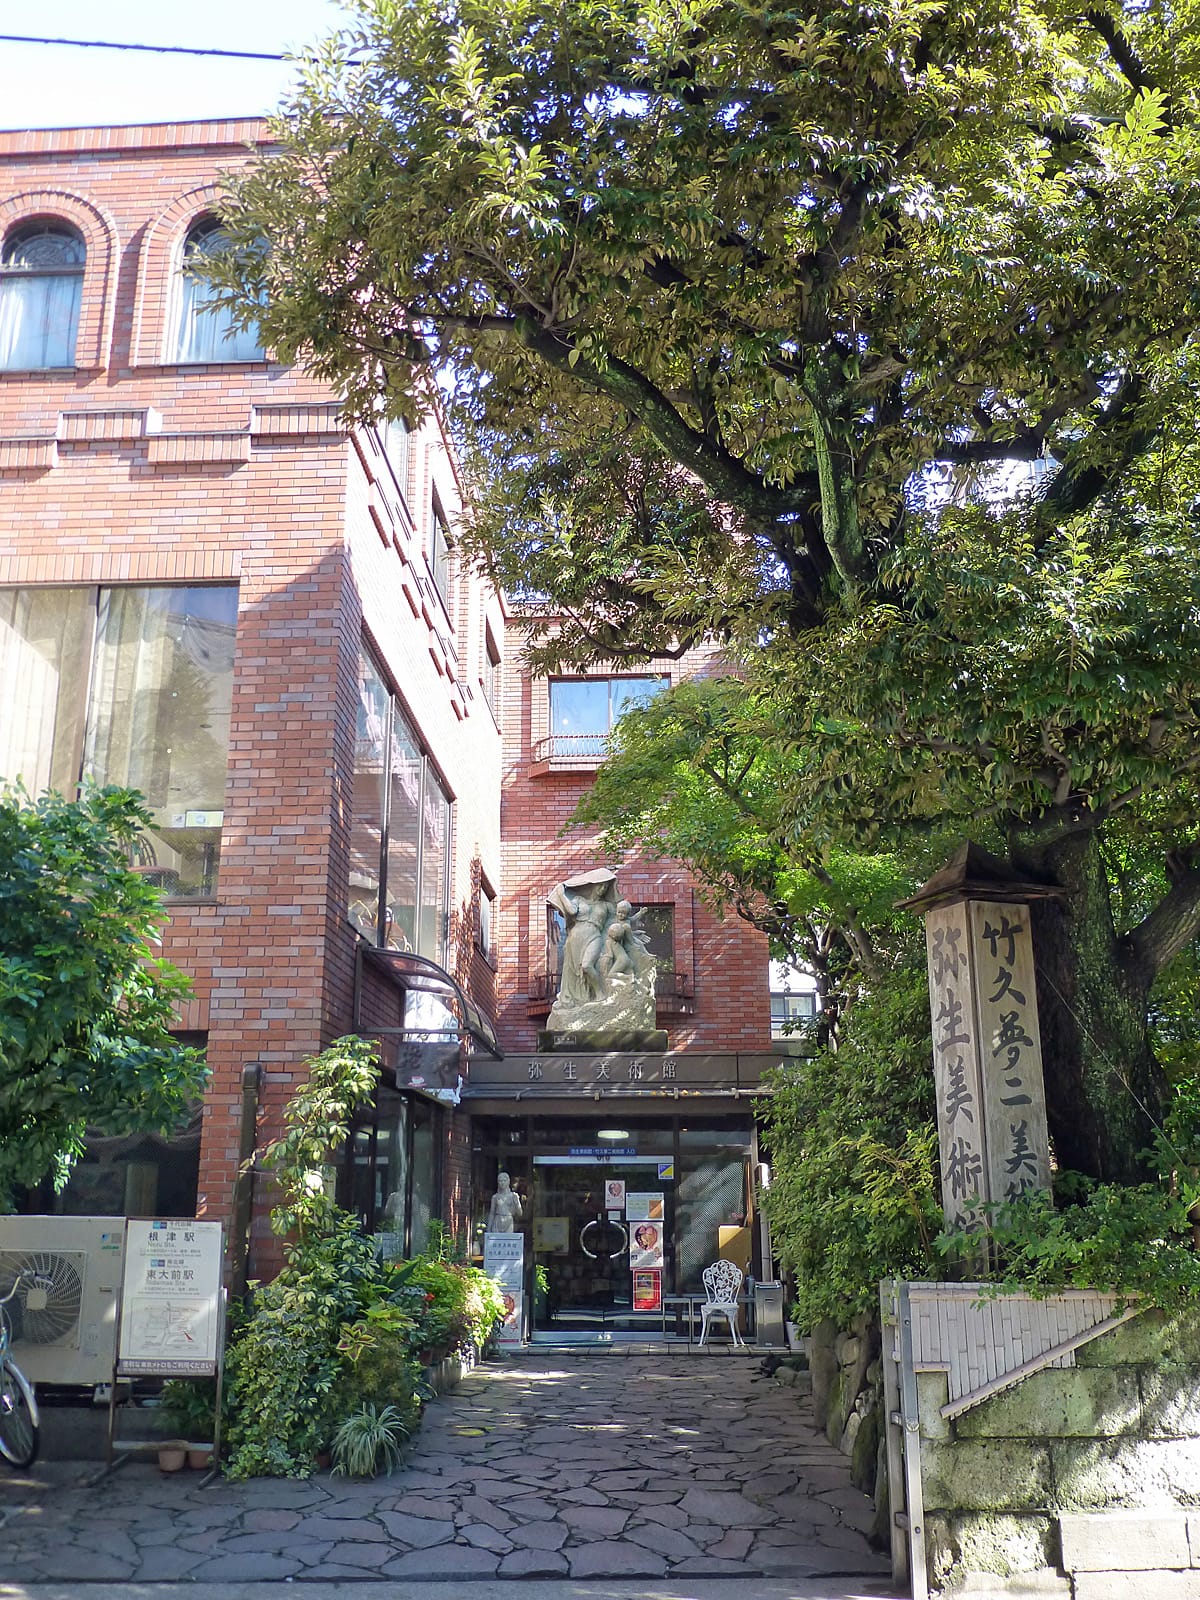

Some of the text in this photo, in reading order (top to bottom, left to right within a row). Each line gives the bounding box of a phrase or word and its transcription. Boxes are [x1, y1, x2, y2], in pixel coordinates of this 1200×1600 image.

[528, 1061, 676, 1080] 弥生美術館
[148, 1231, 195, 1242] 根津駅
[146, 1270, 194, 1280] 東大前駅
